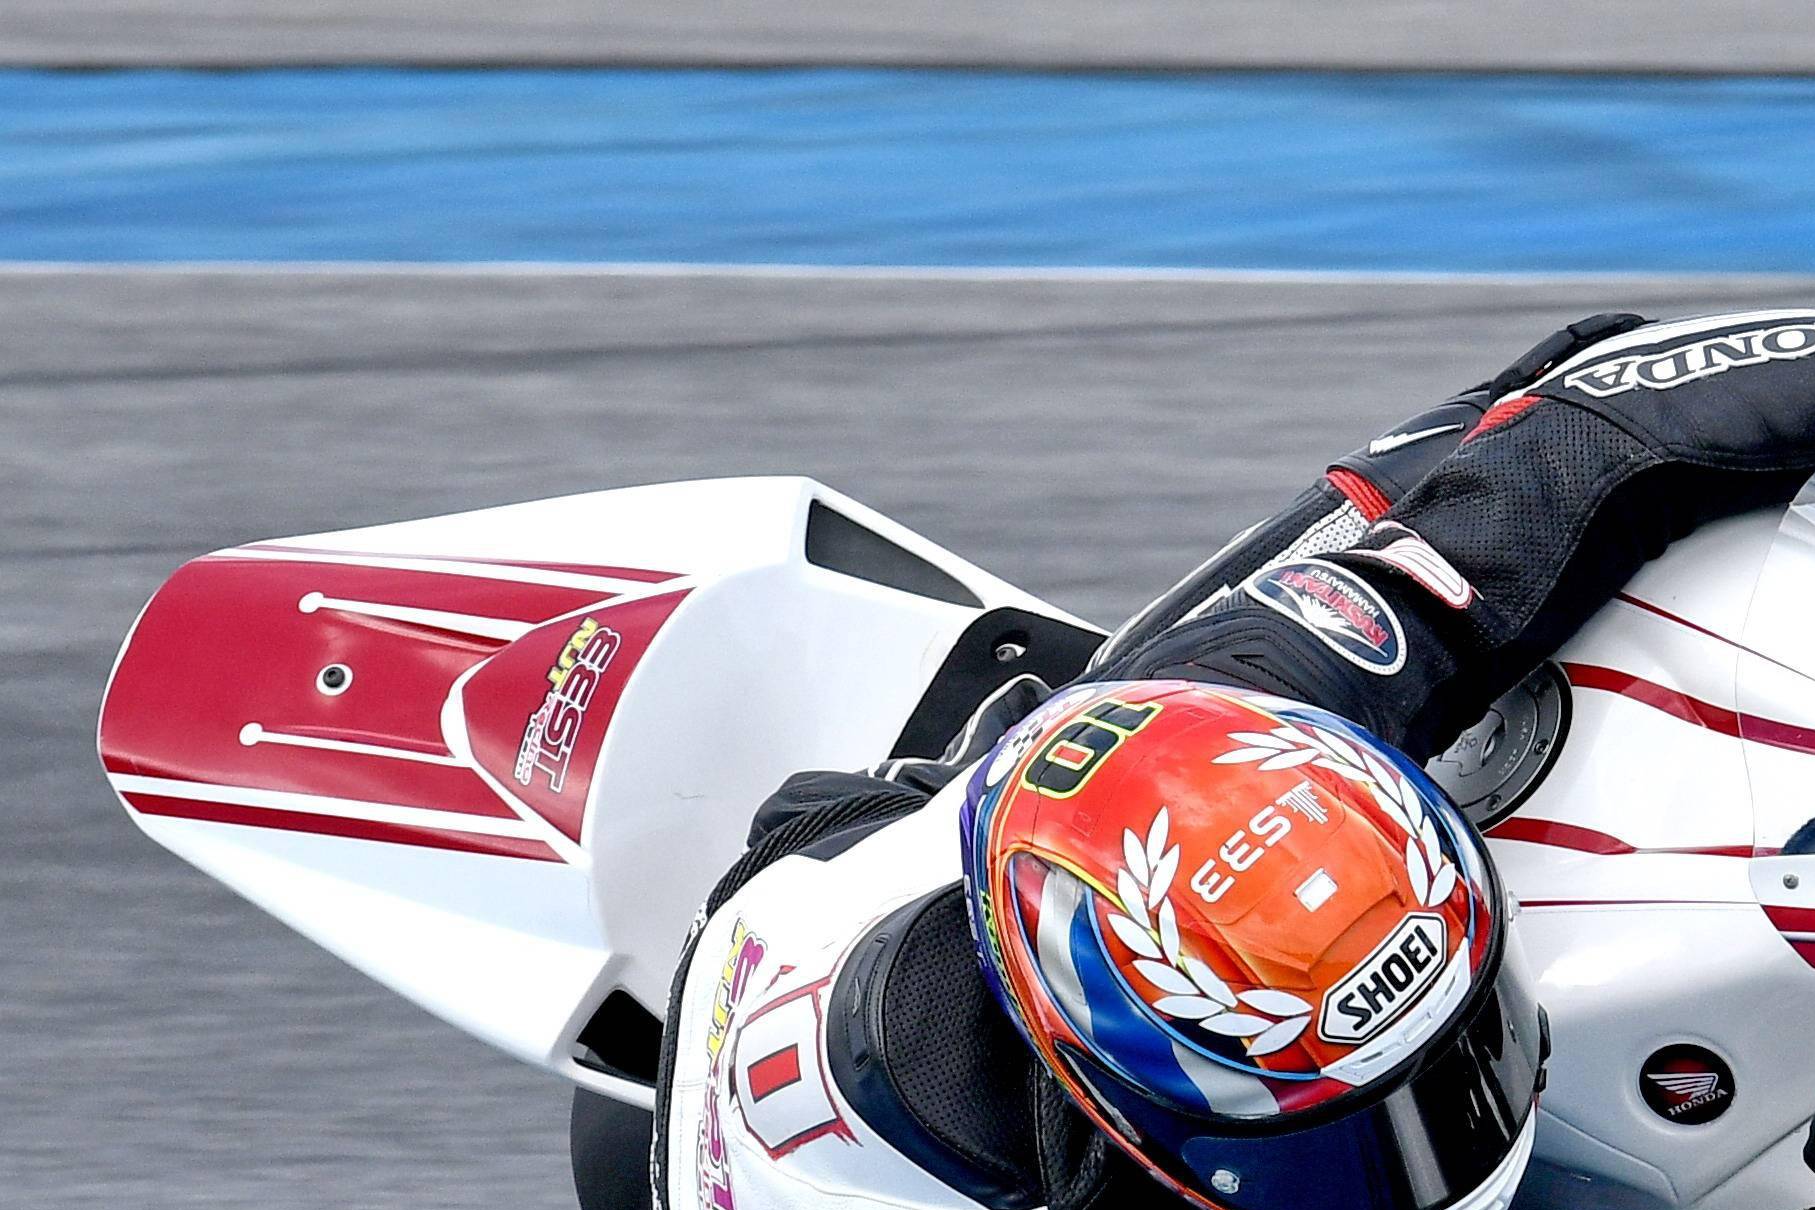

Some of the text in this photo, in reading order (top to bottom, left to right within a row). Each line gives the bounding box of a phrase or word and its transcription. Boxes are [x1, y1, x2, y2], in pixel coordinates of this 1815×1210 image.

[1310, 569, 1381, 618] HAMAMATSU
[547, 617, 599, 692] NUT
[535, 626, 622, 793] EEST
[1336, 925, 1439, 1031] SHOEI
[1667, 1088, 1729, 1116] HONDA
